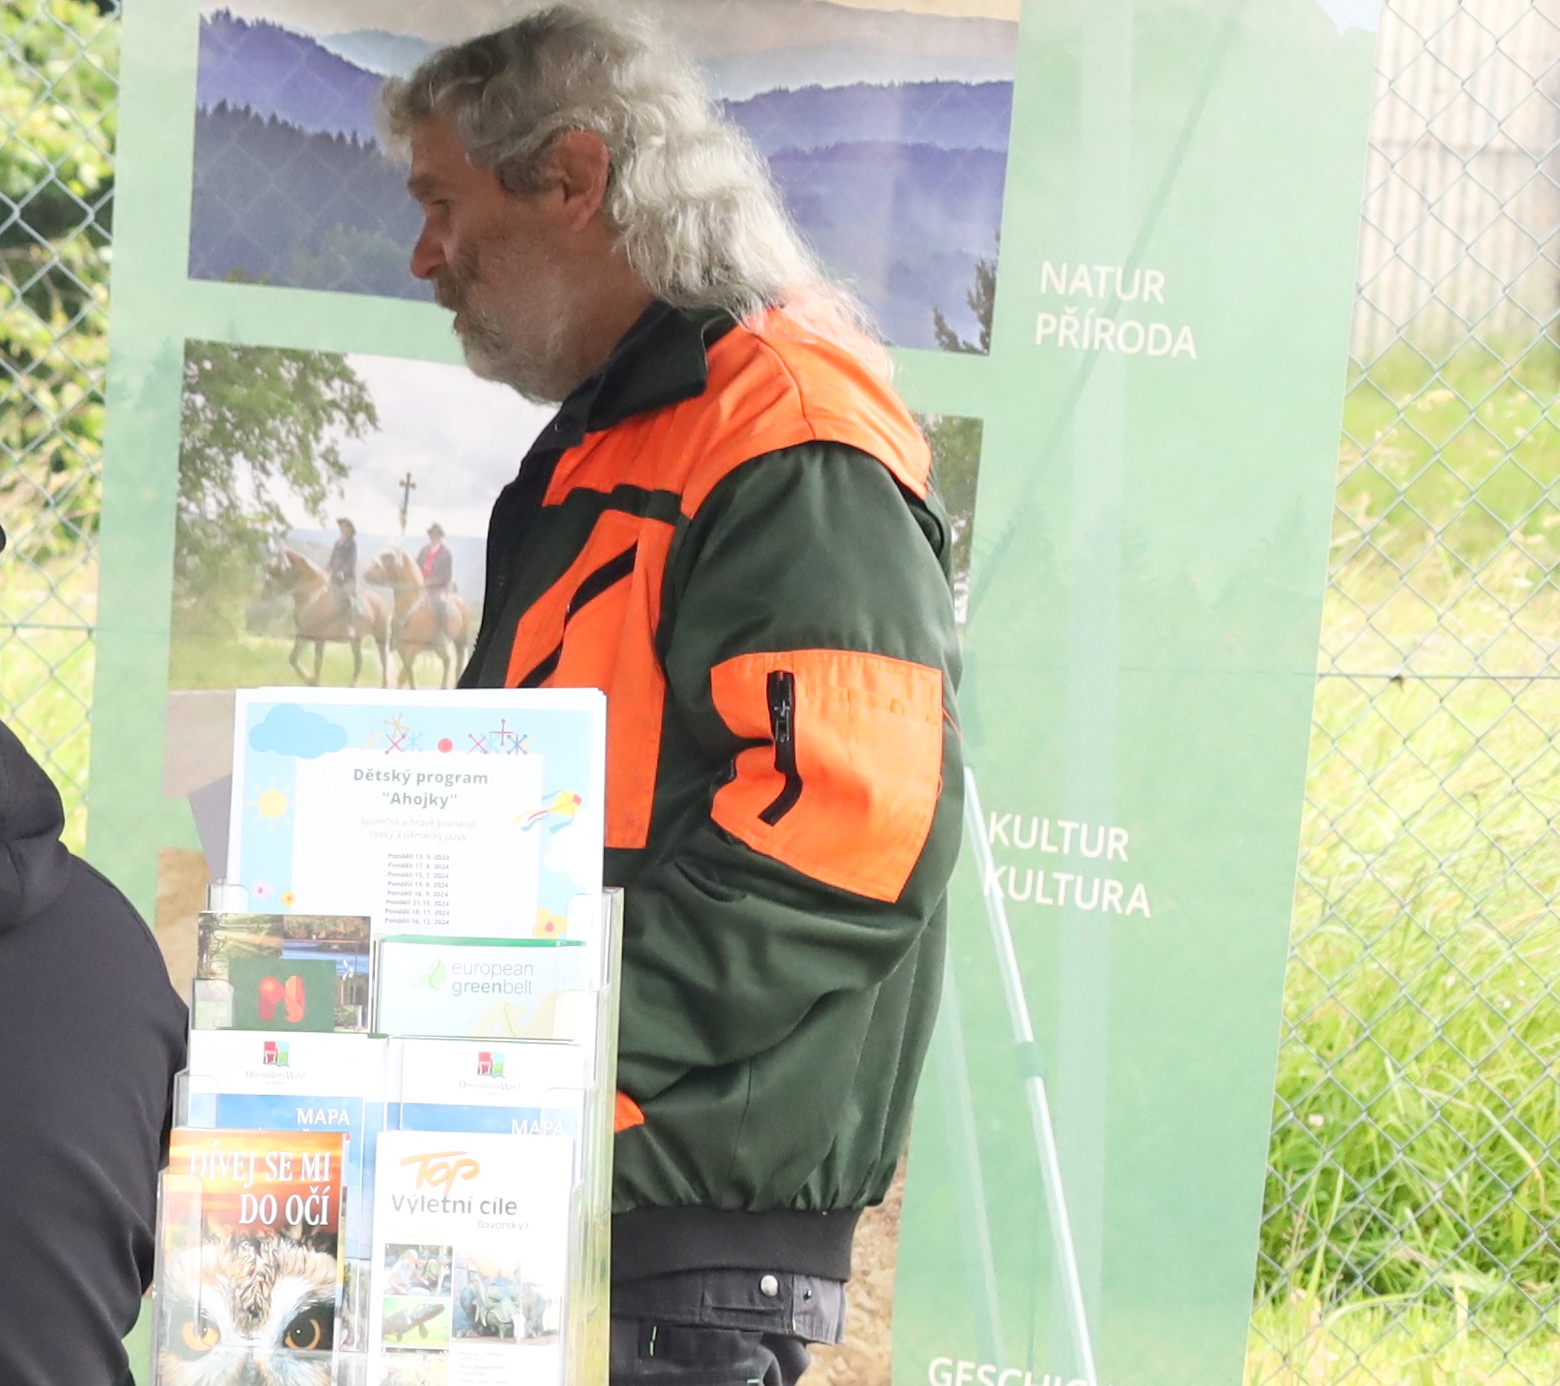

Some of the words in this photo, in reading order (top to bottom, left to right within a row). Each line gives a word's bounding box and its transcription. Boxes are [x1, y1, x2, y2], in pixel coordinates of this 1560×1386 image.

[1039, 260, 1165, 304] NATUR
[1035, 309, 1197, 360] PŘÍRODA
[354, 768, 411, 785] Dětský
[416, 772, 488, 787] program
[383, 792, 457, 809] "Ahojky"
[987, 811, 1129, 862] KULTUR
[982, 864, 1151, 918] KULTURA
[451, 960, 534, 979] european
[451, 979, 533, 997] greenbelt
[296, 1107, 351, 1126] MAPA
[511, 1119, 565, 1135] MAPA
[189, 1140, 256, 1189] DÍVEJ
[264, 1151, 293, 1181] SE
[300, 1152, 331, 1182] MI
[239, 1193, 278, 1225] DO
[285, 1185, 331, 1225] OČÍ
[391, 1193, 474, 1214] Výletní
[479, 1197, 518, 1215] cíle
